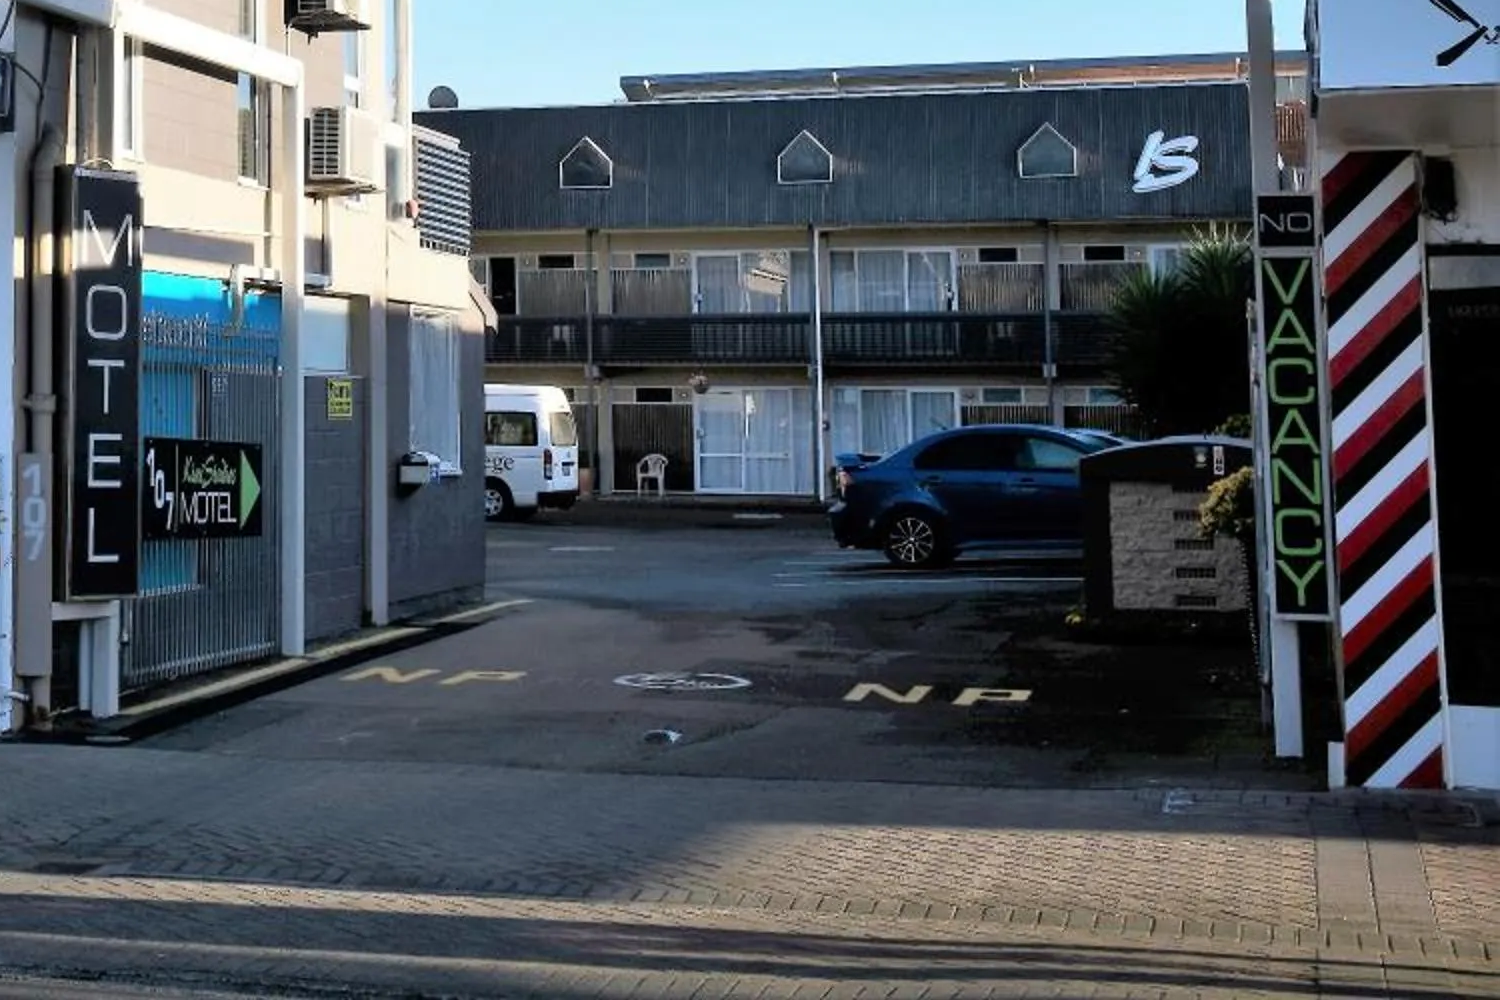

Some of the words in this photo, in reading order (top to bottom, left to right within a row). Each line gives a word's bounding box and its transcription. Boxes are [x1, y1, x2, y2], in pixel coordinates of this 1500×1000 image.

[1259, 211, 1312, 233] NO
[83, 208, 134, 564] MOTEL
[1263, 258, 1326, 608] VACANCY
[23, 462, 47, 561] 107
[146, 447, 175, 531] 107
[180, 491, 237, 524] MOTEL
